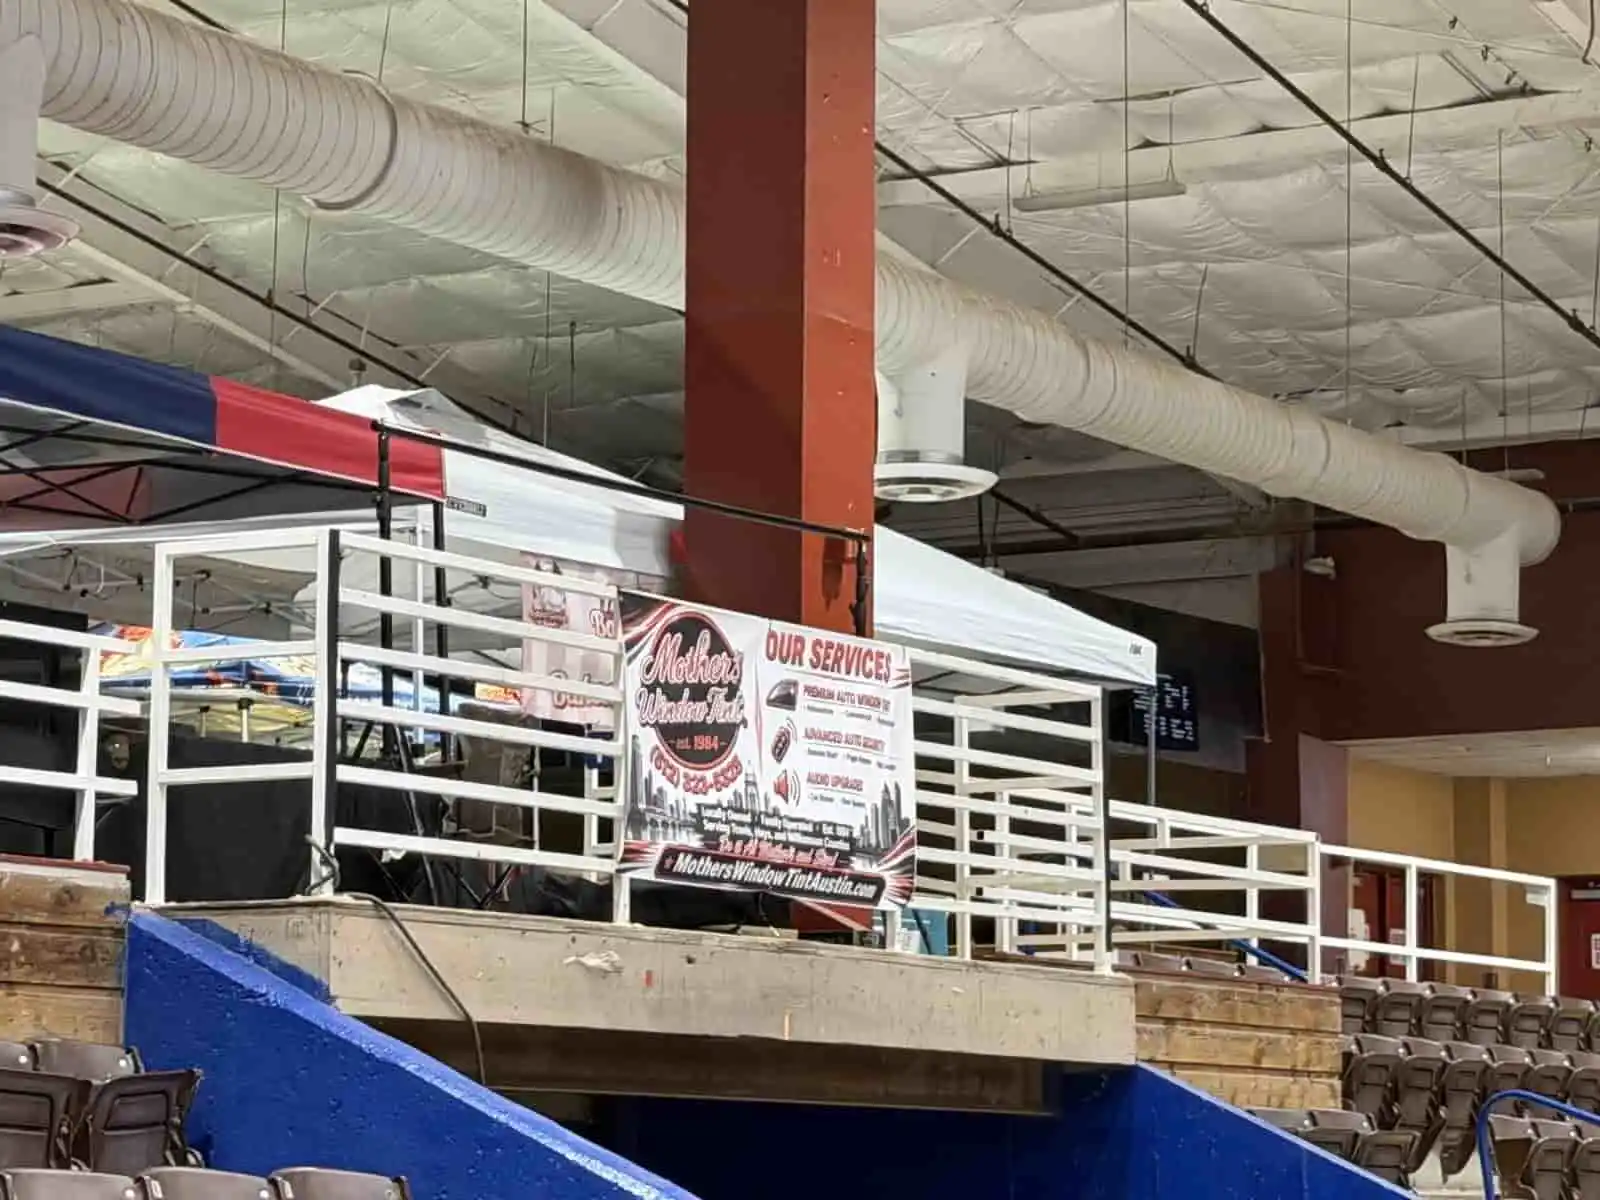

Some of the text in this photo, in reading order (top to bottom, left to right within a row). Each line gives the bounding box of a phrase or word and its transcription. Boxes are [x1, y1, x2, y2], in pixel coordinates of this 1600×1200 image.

[640, 628, 744, 684] Mothers
[766, 630, 806, 666] OUR
[809, 638, 891, 682] SERVICES
[635, 687, 708, 725] Window
[694, 735, 719, 751] 1984
[673, 852, 878, 899] MothersWindowTintAustin.com
